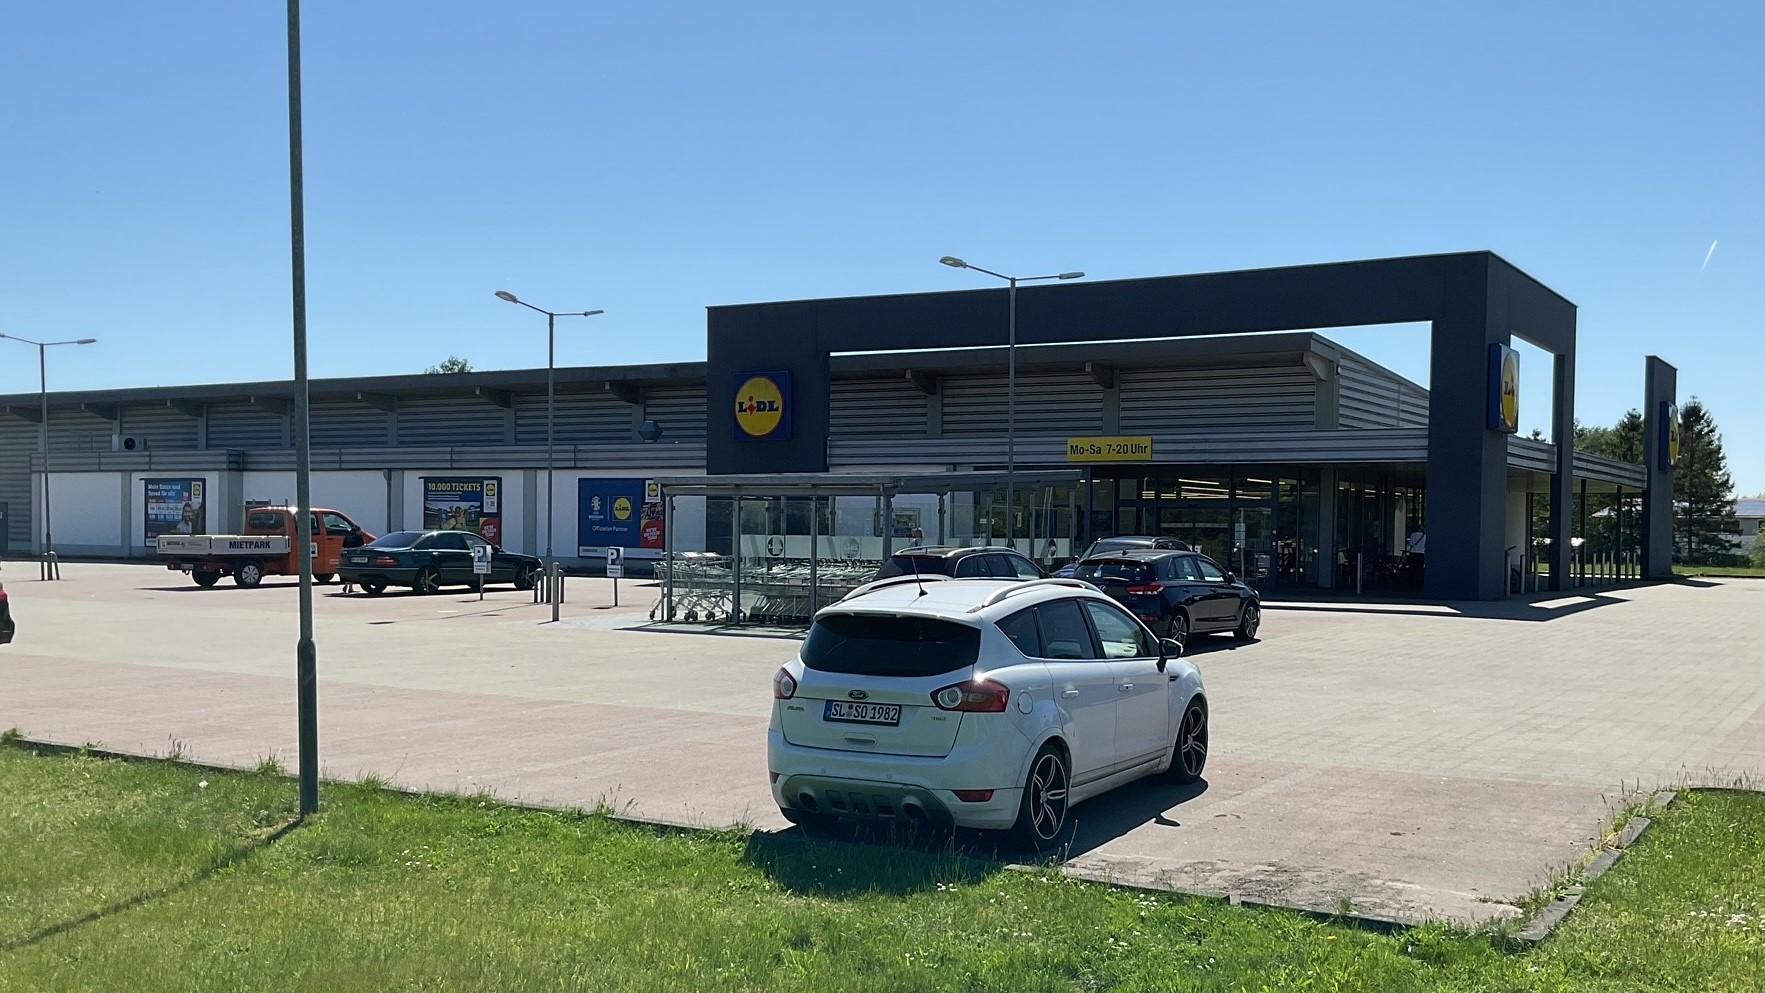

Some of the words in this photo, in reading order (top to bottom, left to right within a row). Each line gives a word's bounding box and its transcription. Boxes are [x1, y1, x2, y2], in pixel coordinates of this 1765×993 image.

[738, 396, 780, 416] LIDL
[1070, 444, 1102, 455] Mo-Sa
[1106, 444, 1129, 454] 7-20
[1131, 443, 1148, 454] Uhr
[428, 483, 451, 491] 10.000
[452, 483, 481, 491] TICKETS
[229, 541, 271, 550] MIETPARK
[474, 546, 484, 562] P
[607, 549, 618, 565] P
[831, 703, 846, 718] SL
[870, 706, 898, 721] 1982
